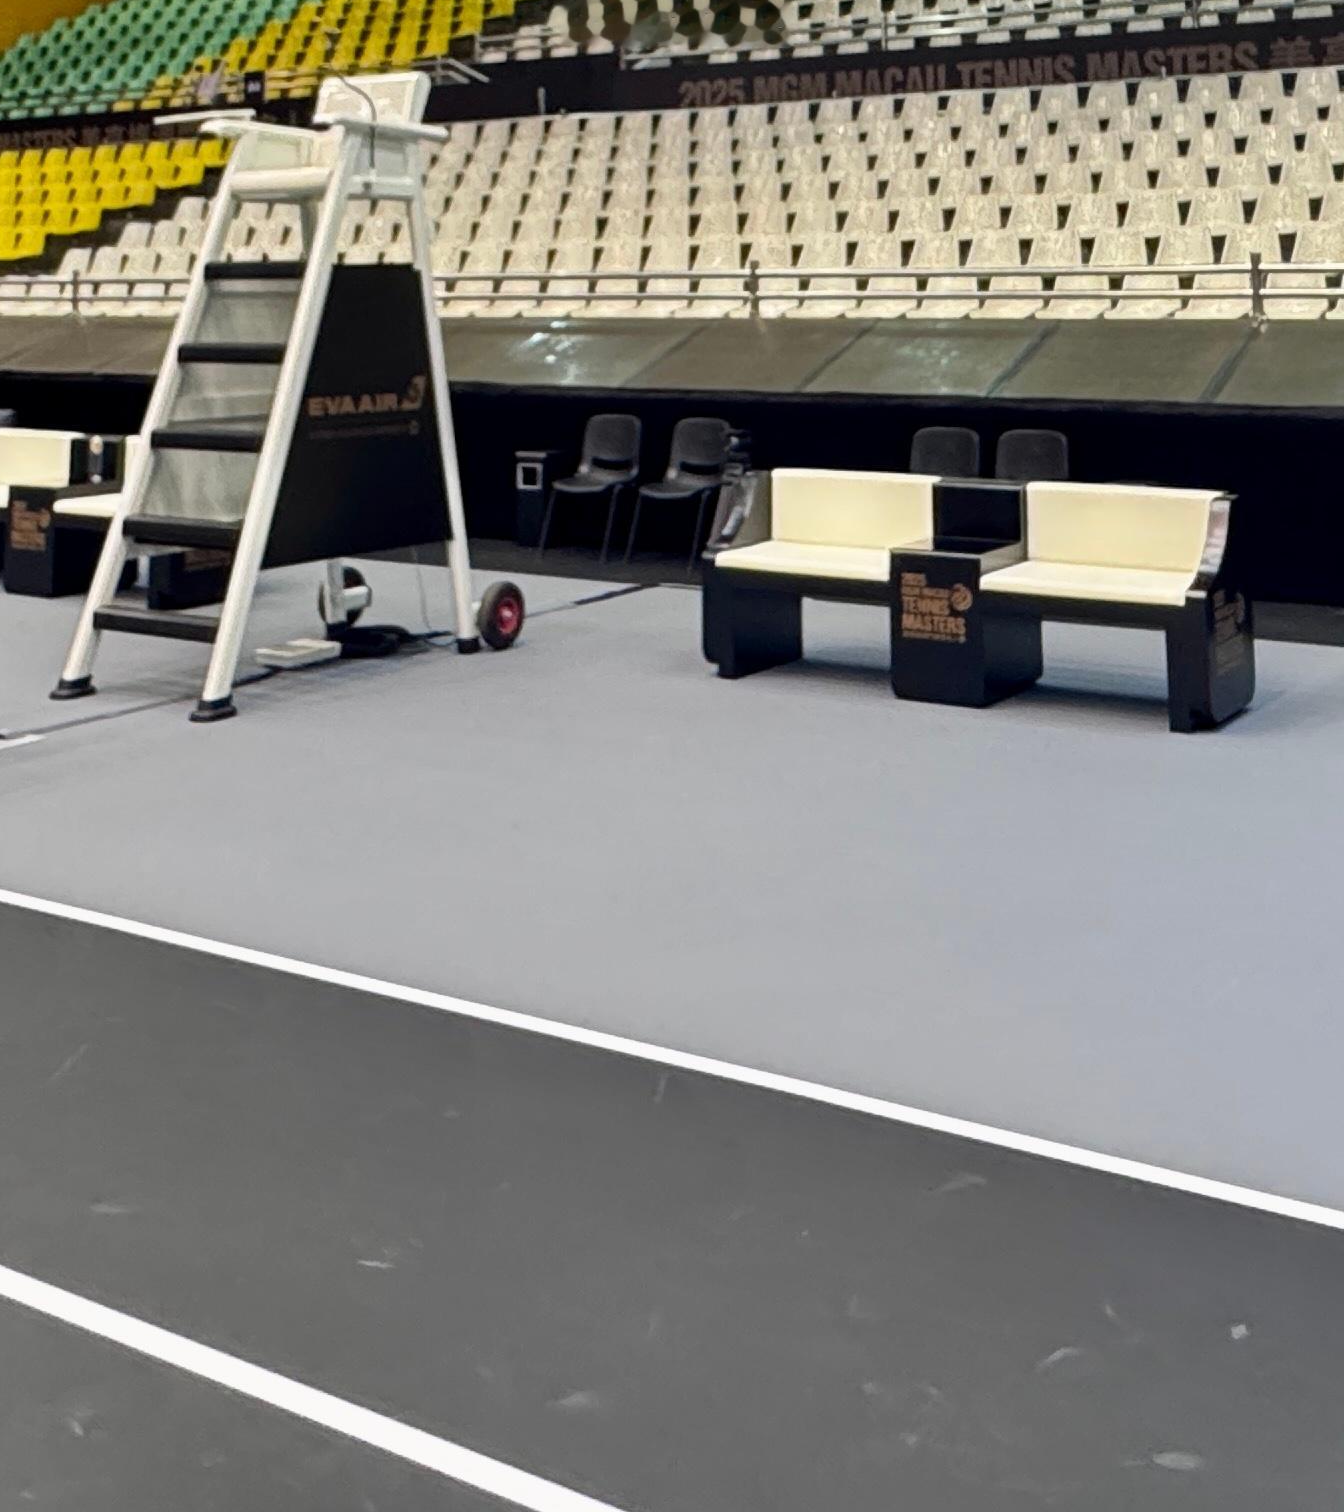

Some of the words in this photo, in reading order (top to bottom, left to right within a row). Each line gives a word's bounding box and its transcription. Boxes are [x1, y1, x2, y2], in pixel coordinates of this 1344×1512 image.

[957, 53, 1076, 87] TENNIS
[1086, 40, 1258, 80] MASTERS
[902, 614, 966, 635] MASTERS
